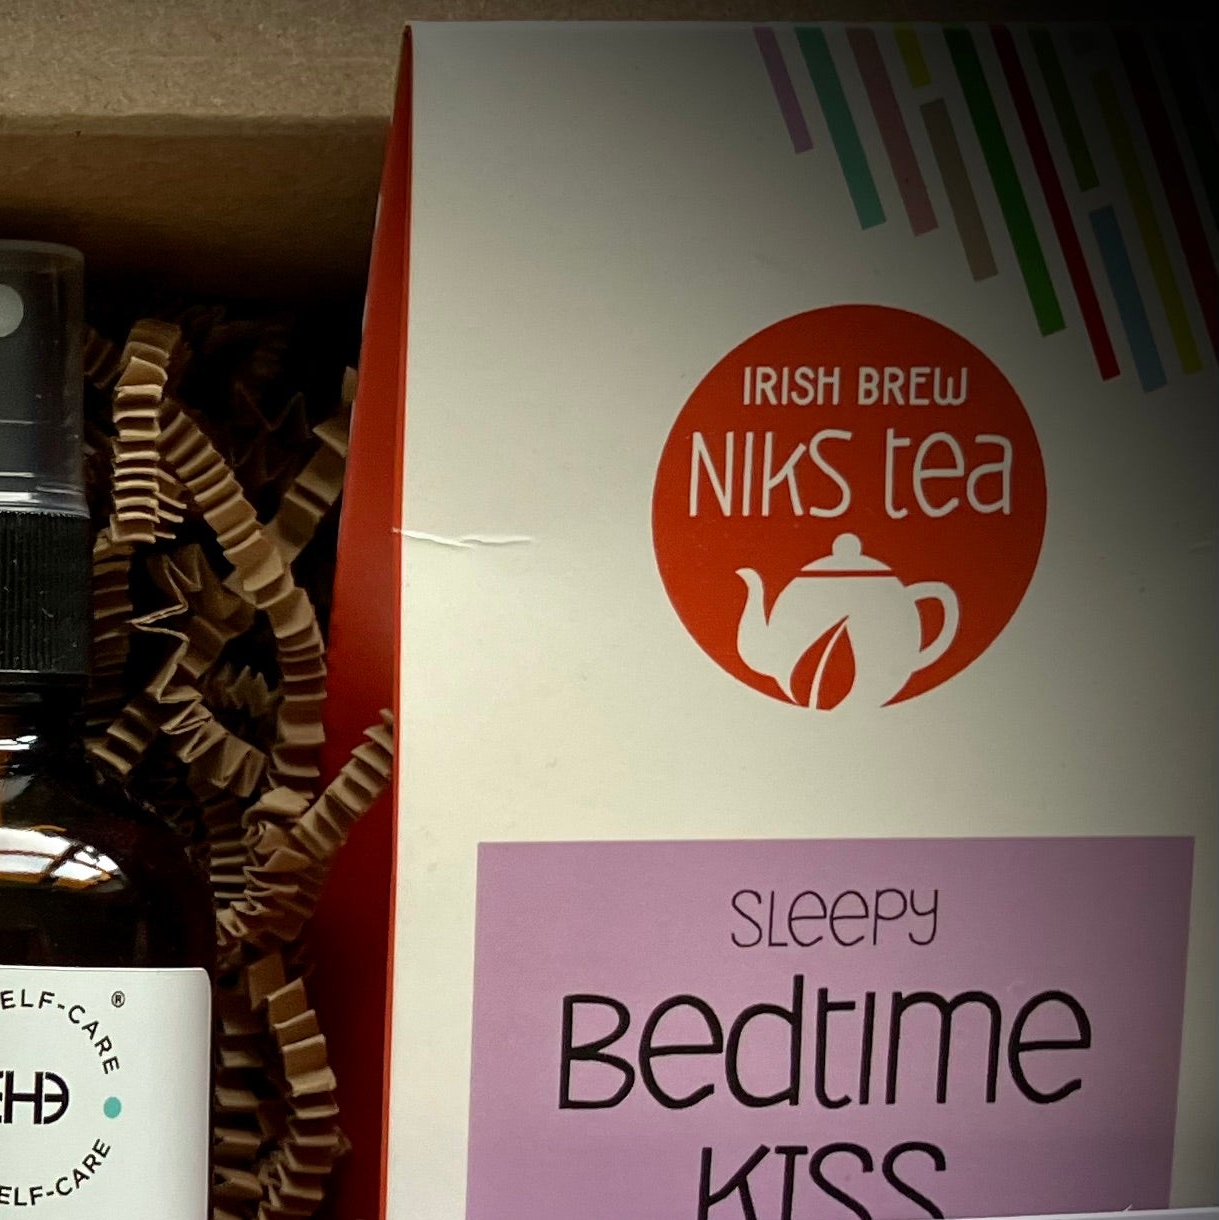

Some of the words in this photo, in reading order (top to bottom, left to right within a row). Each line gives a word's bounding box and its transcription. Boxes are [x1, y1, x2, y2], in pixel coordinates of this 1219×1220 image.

[743, 366, 840, 406] IRISH
[857, 366, 968, 406] BREW
[884, 428, 1013, 519] tea
